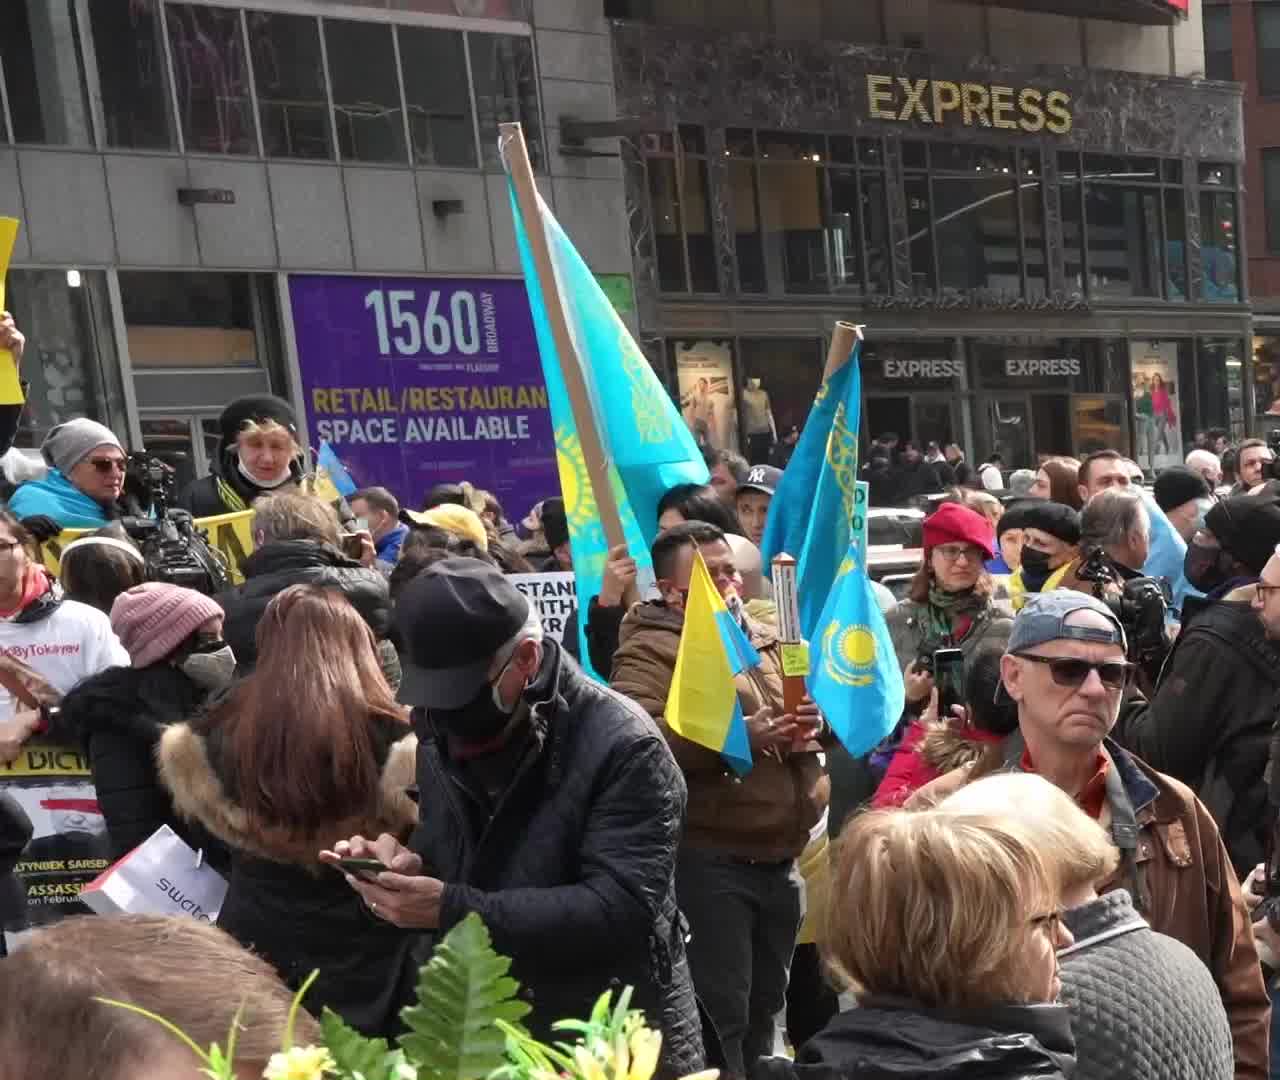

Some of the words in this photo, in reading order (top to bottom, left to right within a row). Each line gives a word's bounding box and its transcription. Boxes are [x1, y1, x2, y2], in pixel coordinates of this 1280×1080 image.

[866, 74, 1073, 135] EXPRESS
[364, 289, 480, 354] 1560
[482, 291, 499, 353] BROADWAY
[884, 359, 964, 377] EXPRESS
[1005, 359, 1080, 375] EXPRESS
[312, 387, 548, 414] RETAIL/RESTAURAN
[317, 418, 397, 444] SPACE
[405, 416, 530, 442] AVAILABLE
[28, 751, 89, 770] DICT
[28, 883, 82, 896] ASSASS
[44, 895, 82, 904] Februa
[155, 878, 210, 922] swatc
